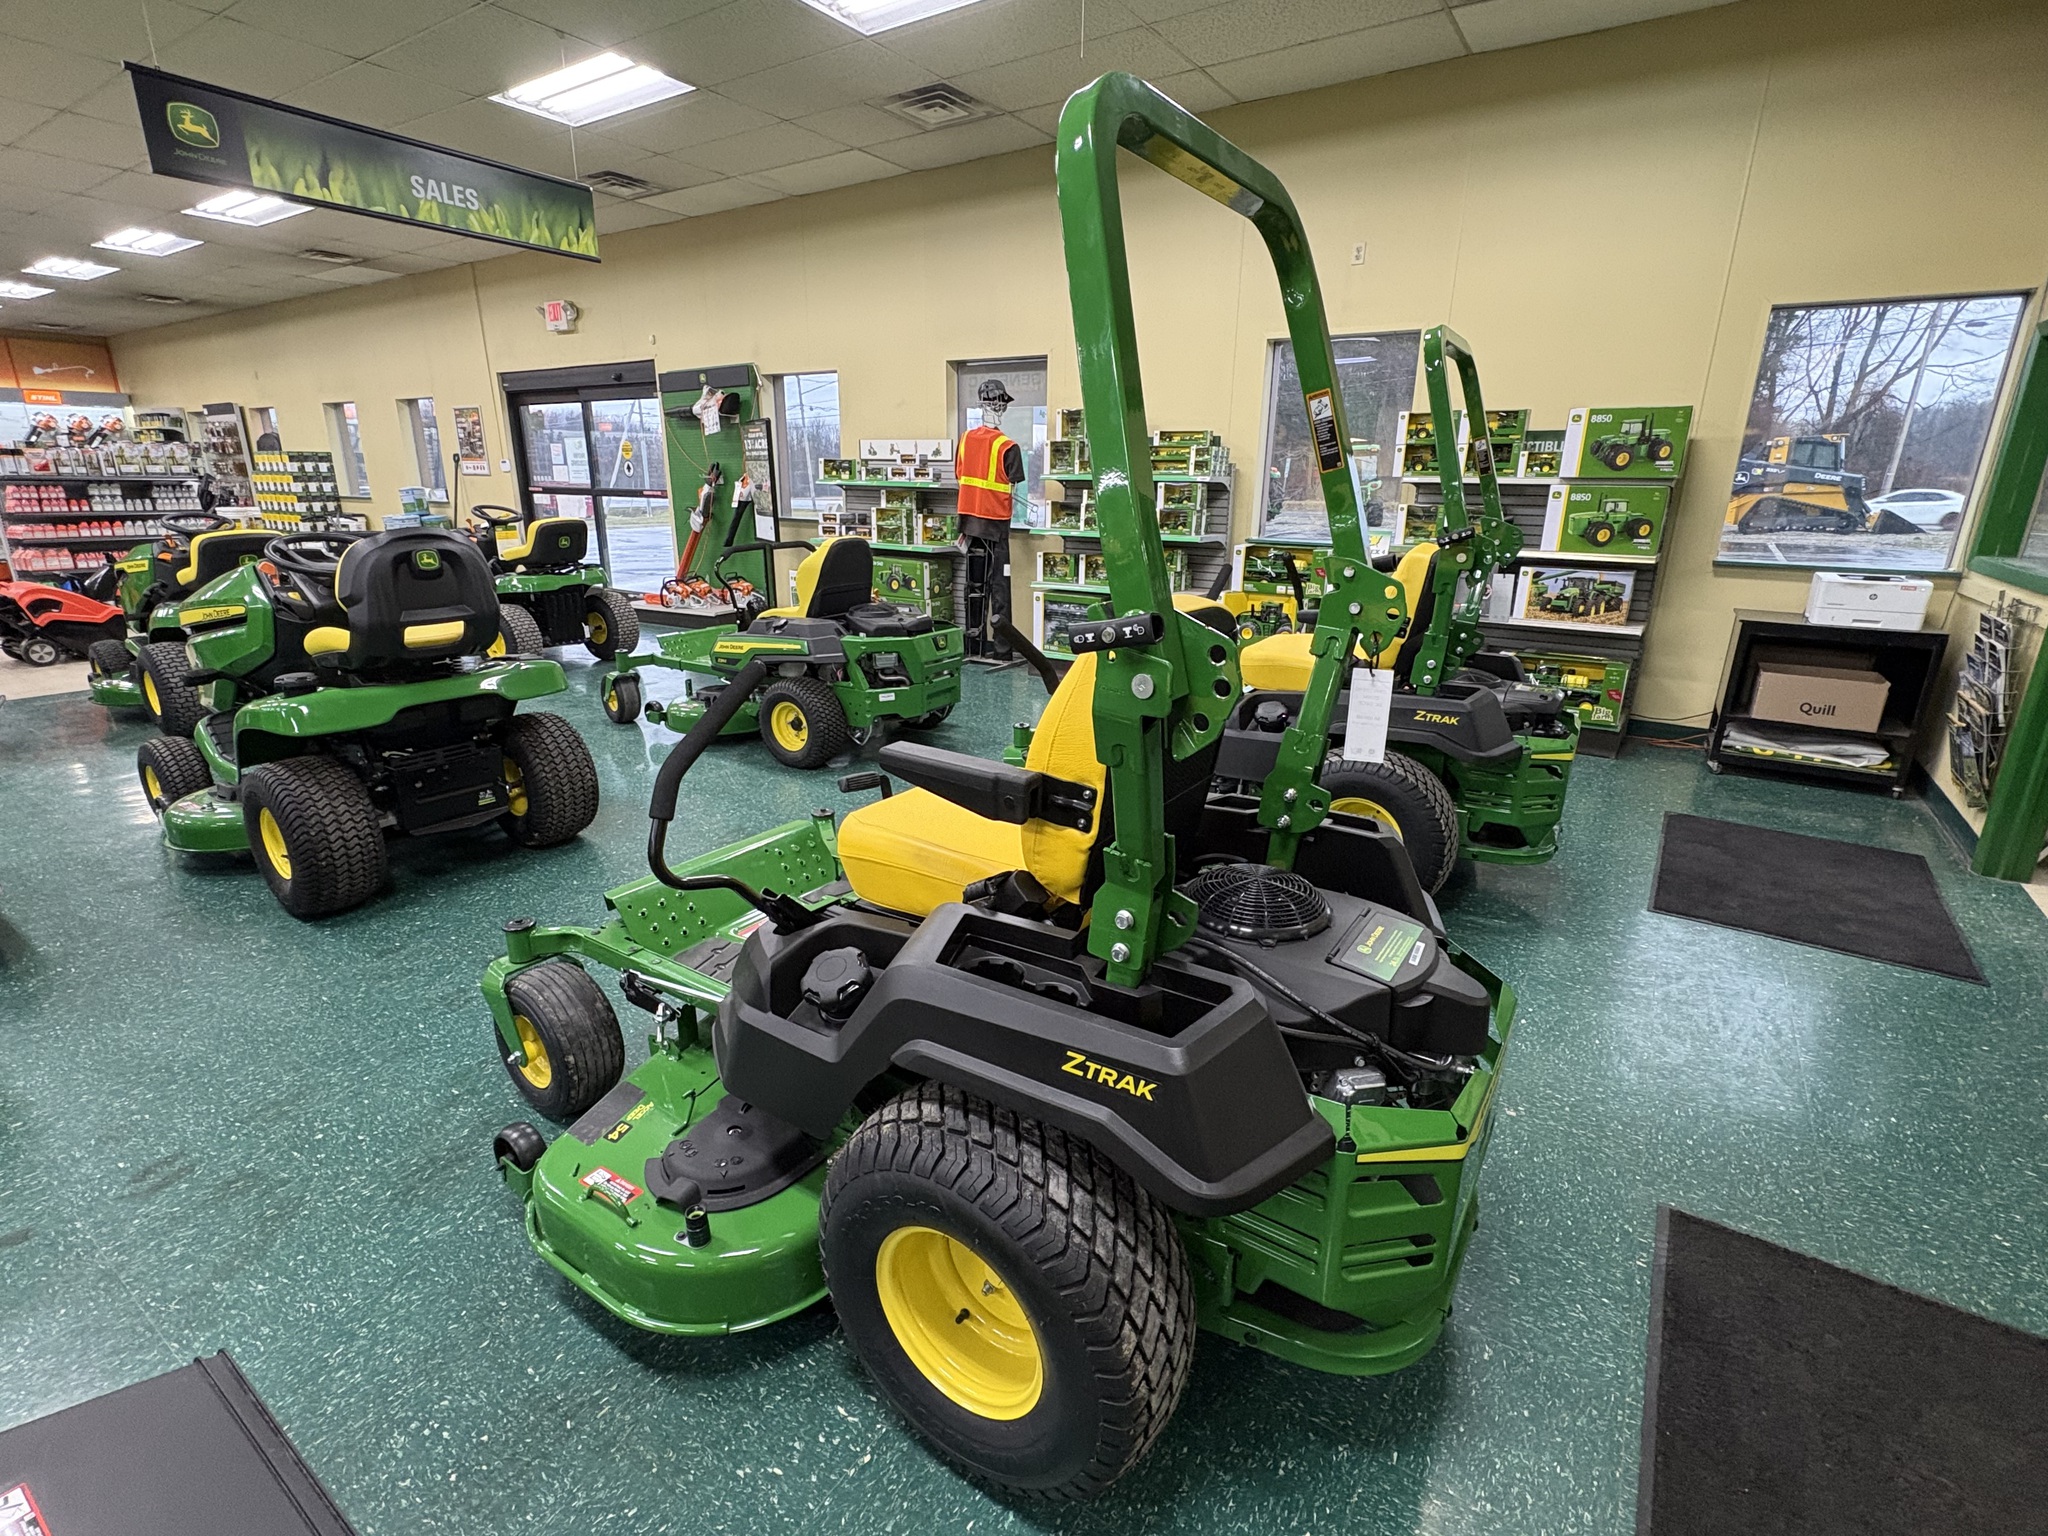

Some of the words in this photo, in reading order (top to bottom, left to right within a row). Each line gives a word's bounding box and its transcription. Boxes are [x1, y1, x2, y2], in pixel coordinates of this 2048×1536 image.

[410, 175, 479, 210] SALES
[548, 302, 562, 321] EXIT
[1590, 414, 1613, 423] 8850
[1814, 472, 1842, 482] DEERE
[1570, 492, 1592, 501] 8850
[202, 612, 213, 620] JOHN
[213, 608, 230, 618] DEERE
[1800, 702, 1836, 716] Quill
[1414, 710, 1460, 726] ZTRAK
[1061, 1050, 1158, 1102] ZTRAK
[608, 1122, 630, 1141] 54
